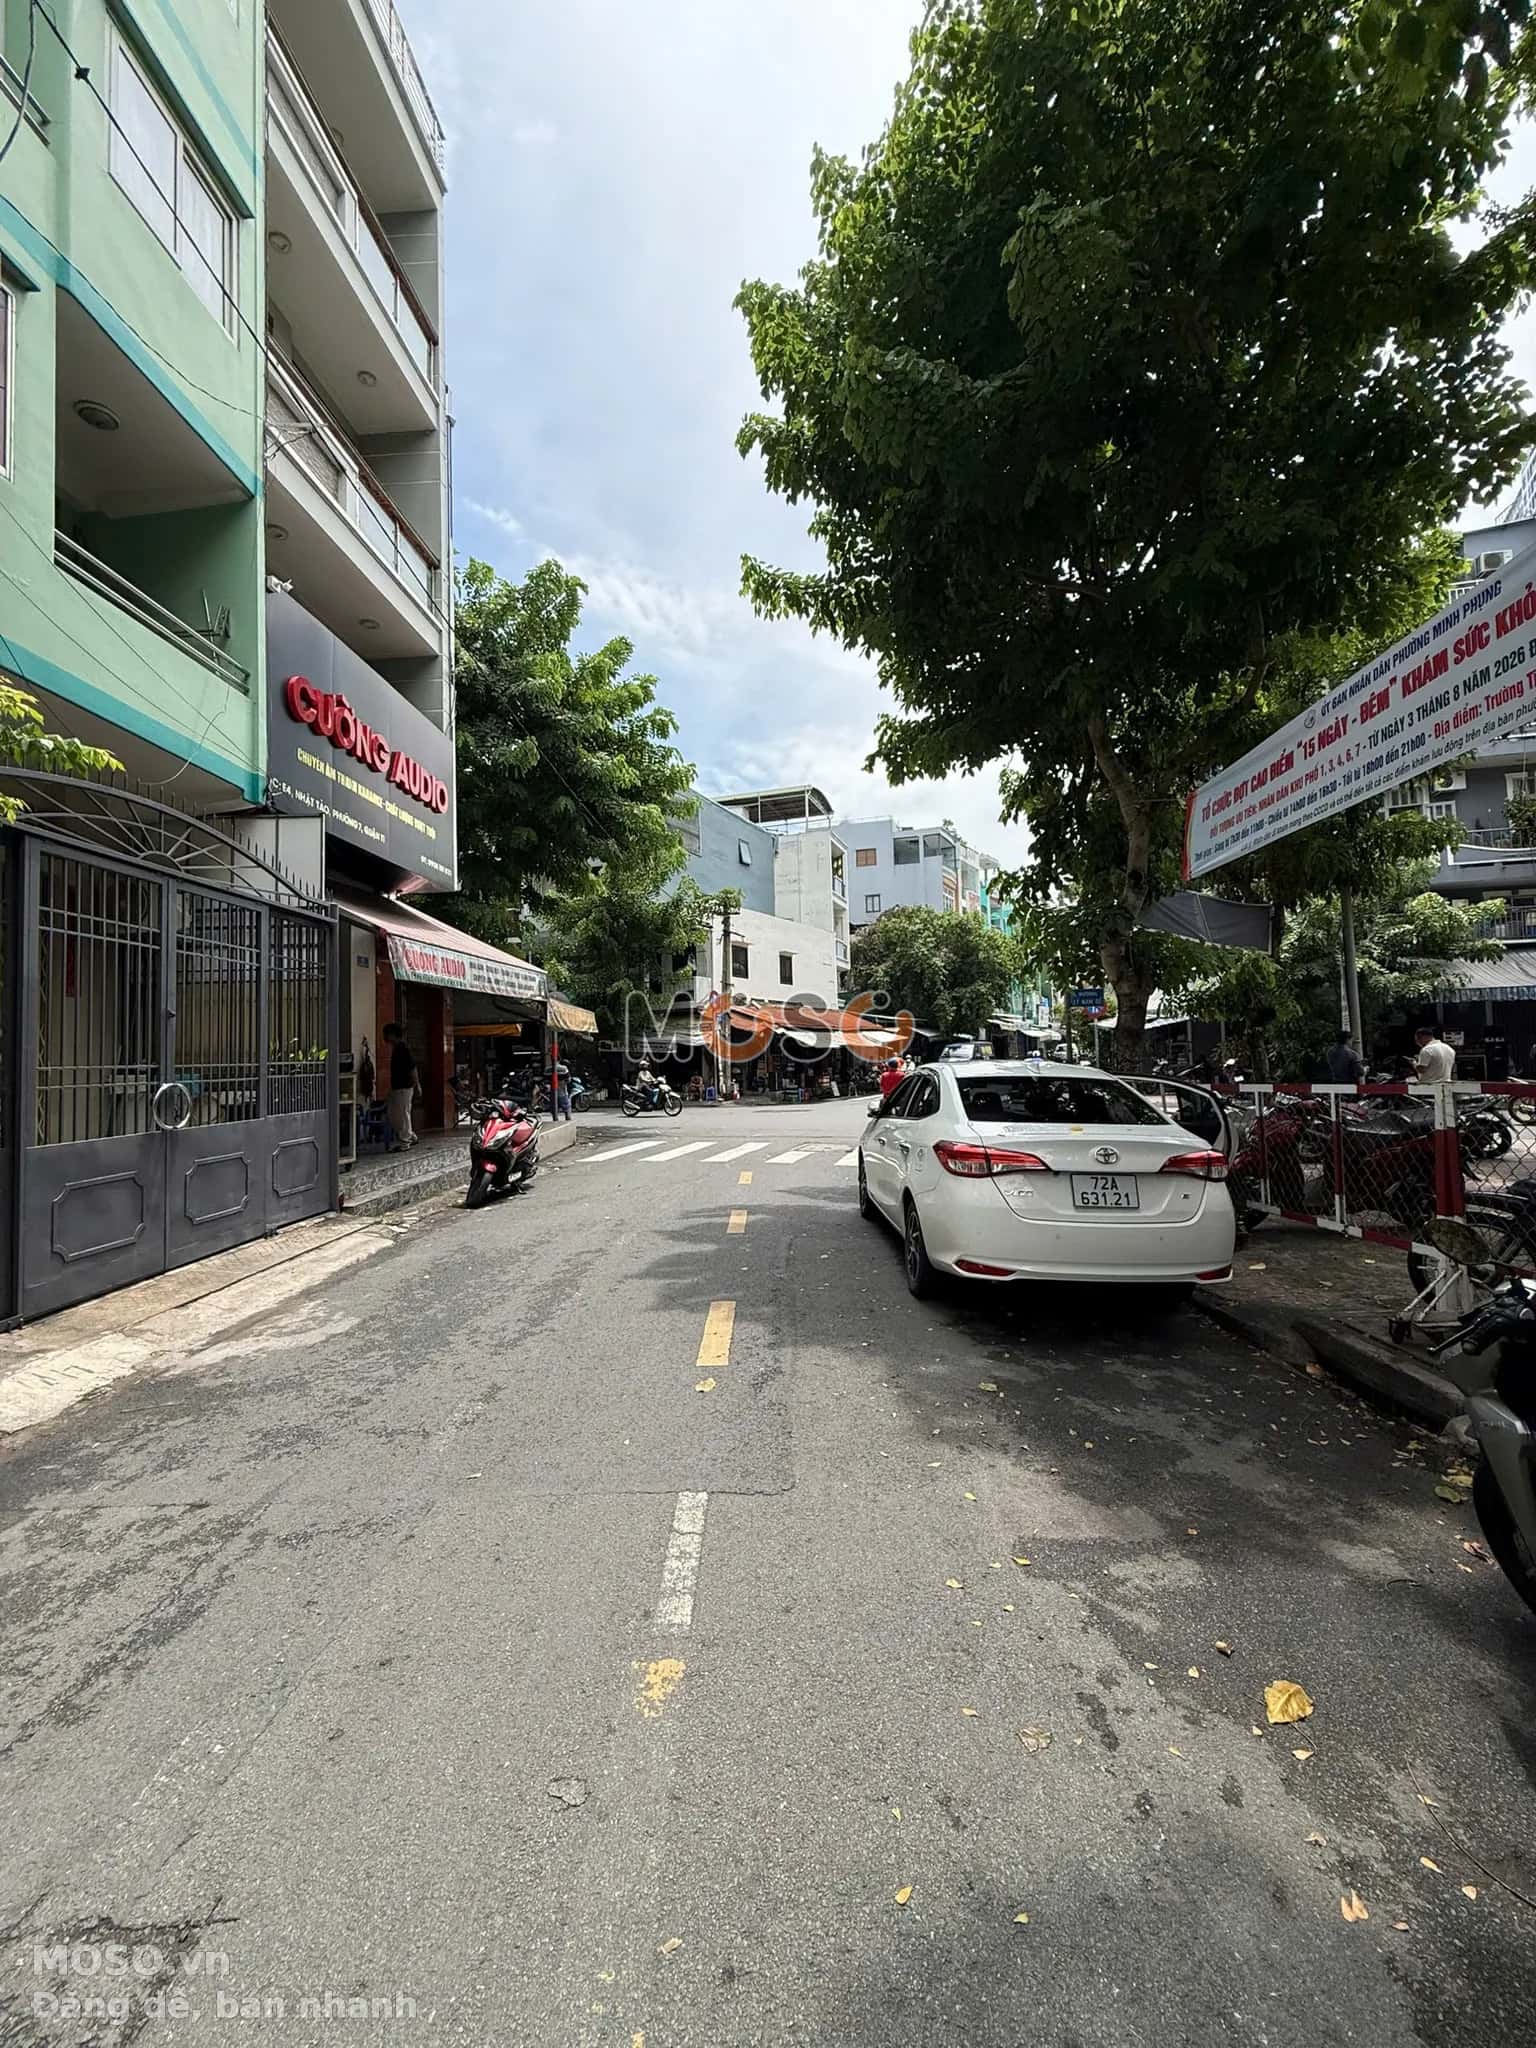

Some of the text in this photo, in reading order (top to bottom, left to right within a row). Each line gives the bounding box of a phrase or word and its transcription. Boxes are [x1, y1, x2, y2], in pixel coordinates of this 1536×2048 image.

[1349, 672, 1371, 698] NHÂN
[1373, 658, 1391, 682] DÂN
[1392, 631, 1431, 668] PHƯỜNG
[1433, 609, 1461, 641] MINH
[1463, 580, 1503, 620] PHỤNG
[1251, 767, 1268, 792] CAO
[1318, 714, 1349, 752] NGÀY
[1402, 648, 1449, 698] KHÁM
[1454, 621, 1491, 665] SỨC
[1355, 743, 1361, 757] 7
[1368, 729, 1380, 749] TỪ
[1381, 716, 1405, 743] NGÀY
[1407, 711, 1414, 728] 3
[1416, 690, 1450, 722] THÁNG
[1453, 684, 1460, 701] 8
[1463, 666, 1491, 696] NĂM
[1494, 646, 1526, 678] 2026
[1386, 744, 1400, 765] đến
[1401, 732, 1426, 757] 21h00
[1434, 720, 1450, 740] Địa
[1453, 702, 1482, 729] điểm:
[1484, 680, 1525, 712] Trường
[1444, 738, 1464, 754] động
[1466, 728, 1481, 743] trên
[1483, 720, 1496, 735] địa
[1498, 712, 1514, 727] bàn
[386, 751, 449, 814] AUDIO
[441, 956, 466, 980] AUDIO
[1080, 1191, 1131, 1206] 631.21
[1090, 1176, 1118, 1191] 72A
